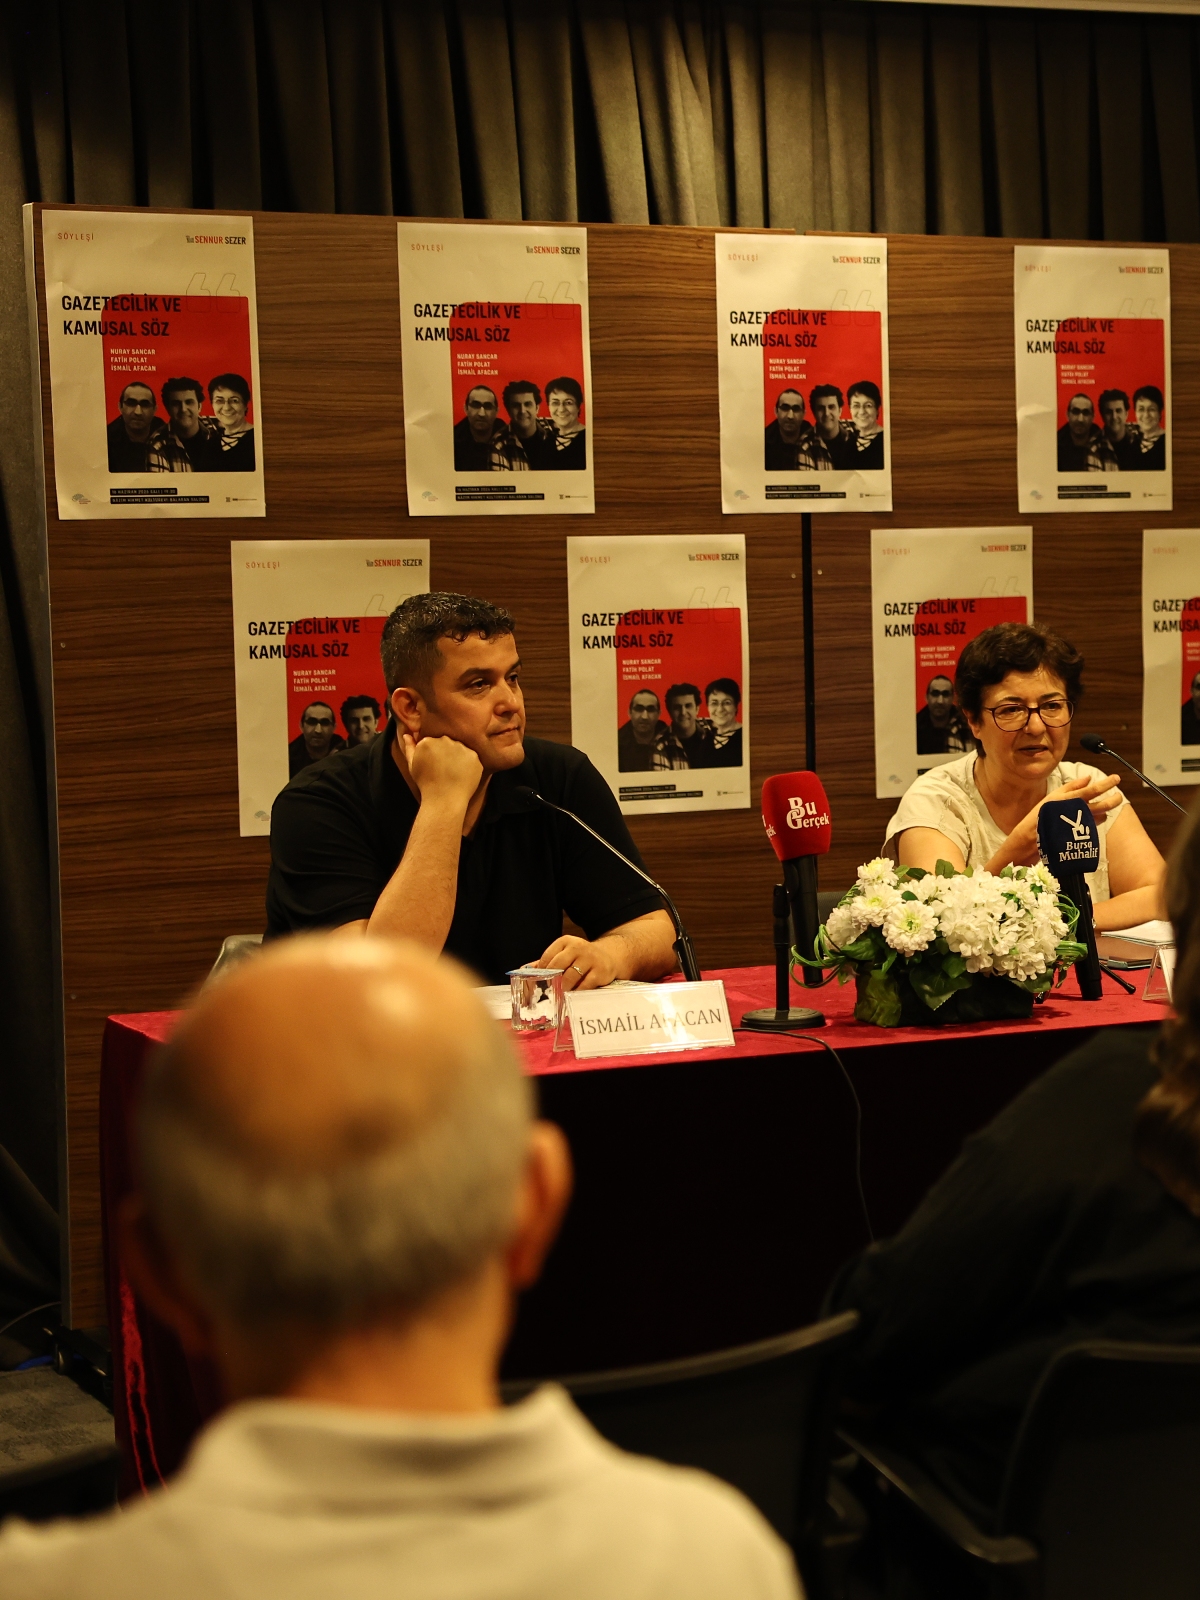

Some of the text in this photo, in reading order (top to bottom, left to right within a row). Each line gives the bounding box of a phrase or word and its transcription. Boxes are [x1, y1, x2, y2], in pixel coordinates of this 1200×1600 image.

[58, 232, 94, 242] SÖYLEŞİ
[195, 235, 223, 244] SENNUR
[225, 236, 246, 245] SEZER
[411, 244, 444, 252] SÖYLEŞİ
[534, 246, 560, 254] SENNUR
[561, 247, 581, 255] SEZER
[62, 293, 181, 312] GAZETECİLİK VE
[414, 301, 521, 319] GAZETECİLİK VE
[730, 309, 827, 326] GAZETECİLİK VE
[1026, 317, 1114, 333] GAZETECİLİK VE
[63, 318, 170, 336] KAMUSAL SÖZ
[415, 325, 511, 342] KAMUSAL SÖZ
[731, 331, 817, 348] KAMUSAL SÖZ
[1027, 338, 1106, 354] KAMUSAL SÖZ
[245, 562, 280, 570] SÖYLEŞİ
[374, 559, 401, 567] SENNUR
[884, 598, 975, 615] GAZETECİLİK VE
[582, 609, 684, 626] GAZETECİLİK VE
[248, 617, 360, 636] GAZETECİLİK VE
[885, 619, 966, 637] KAMUSAL SÖZ
[582, 630, 673, 649] KAMUSAL SÖZ
[249, 640, 349, 659] KAMUSAL SÖZ
[787, 797, 817, 819] Bu
[786, 808, 829, 829] Gerçek
[1066, 841, 1093, 850] Bursa
[1059, 848, 1098, 862] Muhalif
[579, 1012, 645, 1035] İSMAİL
